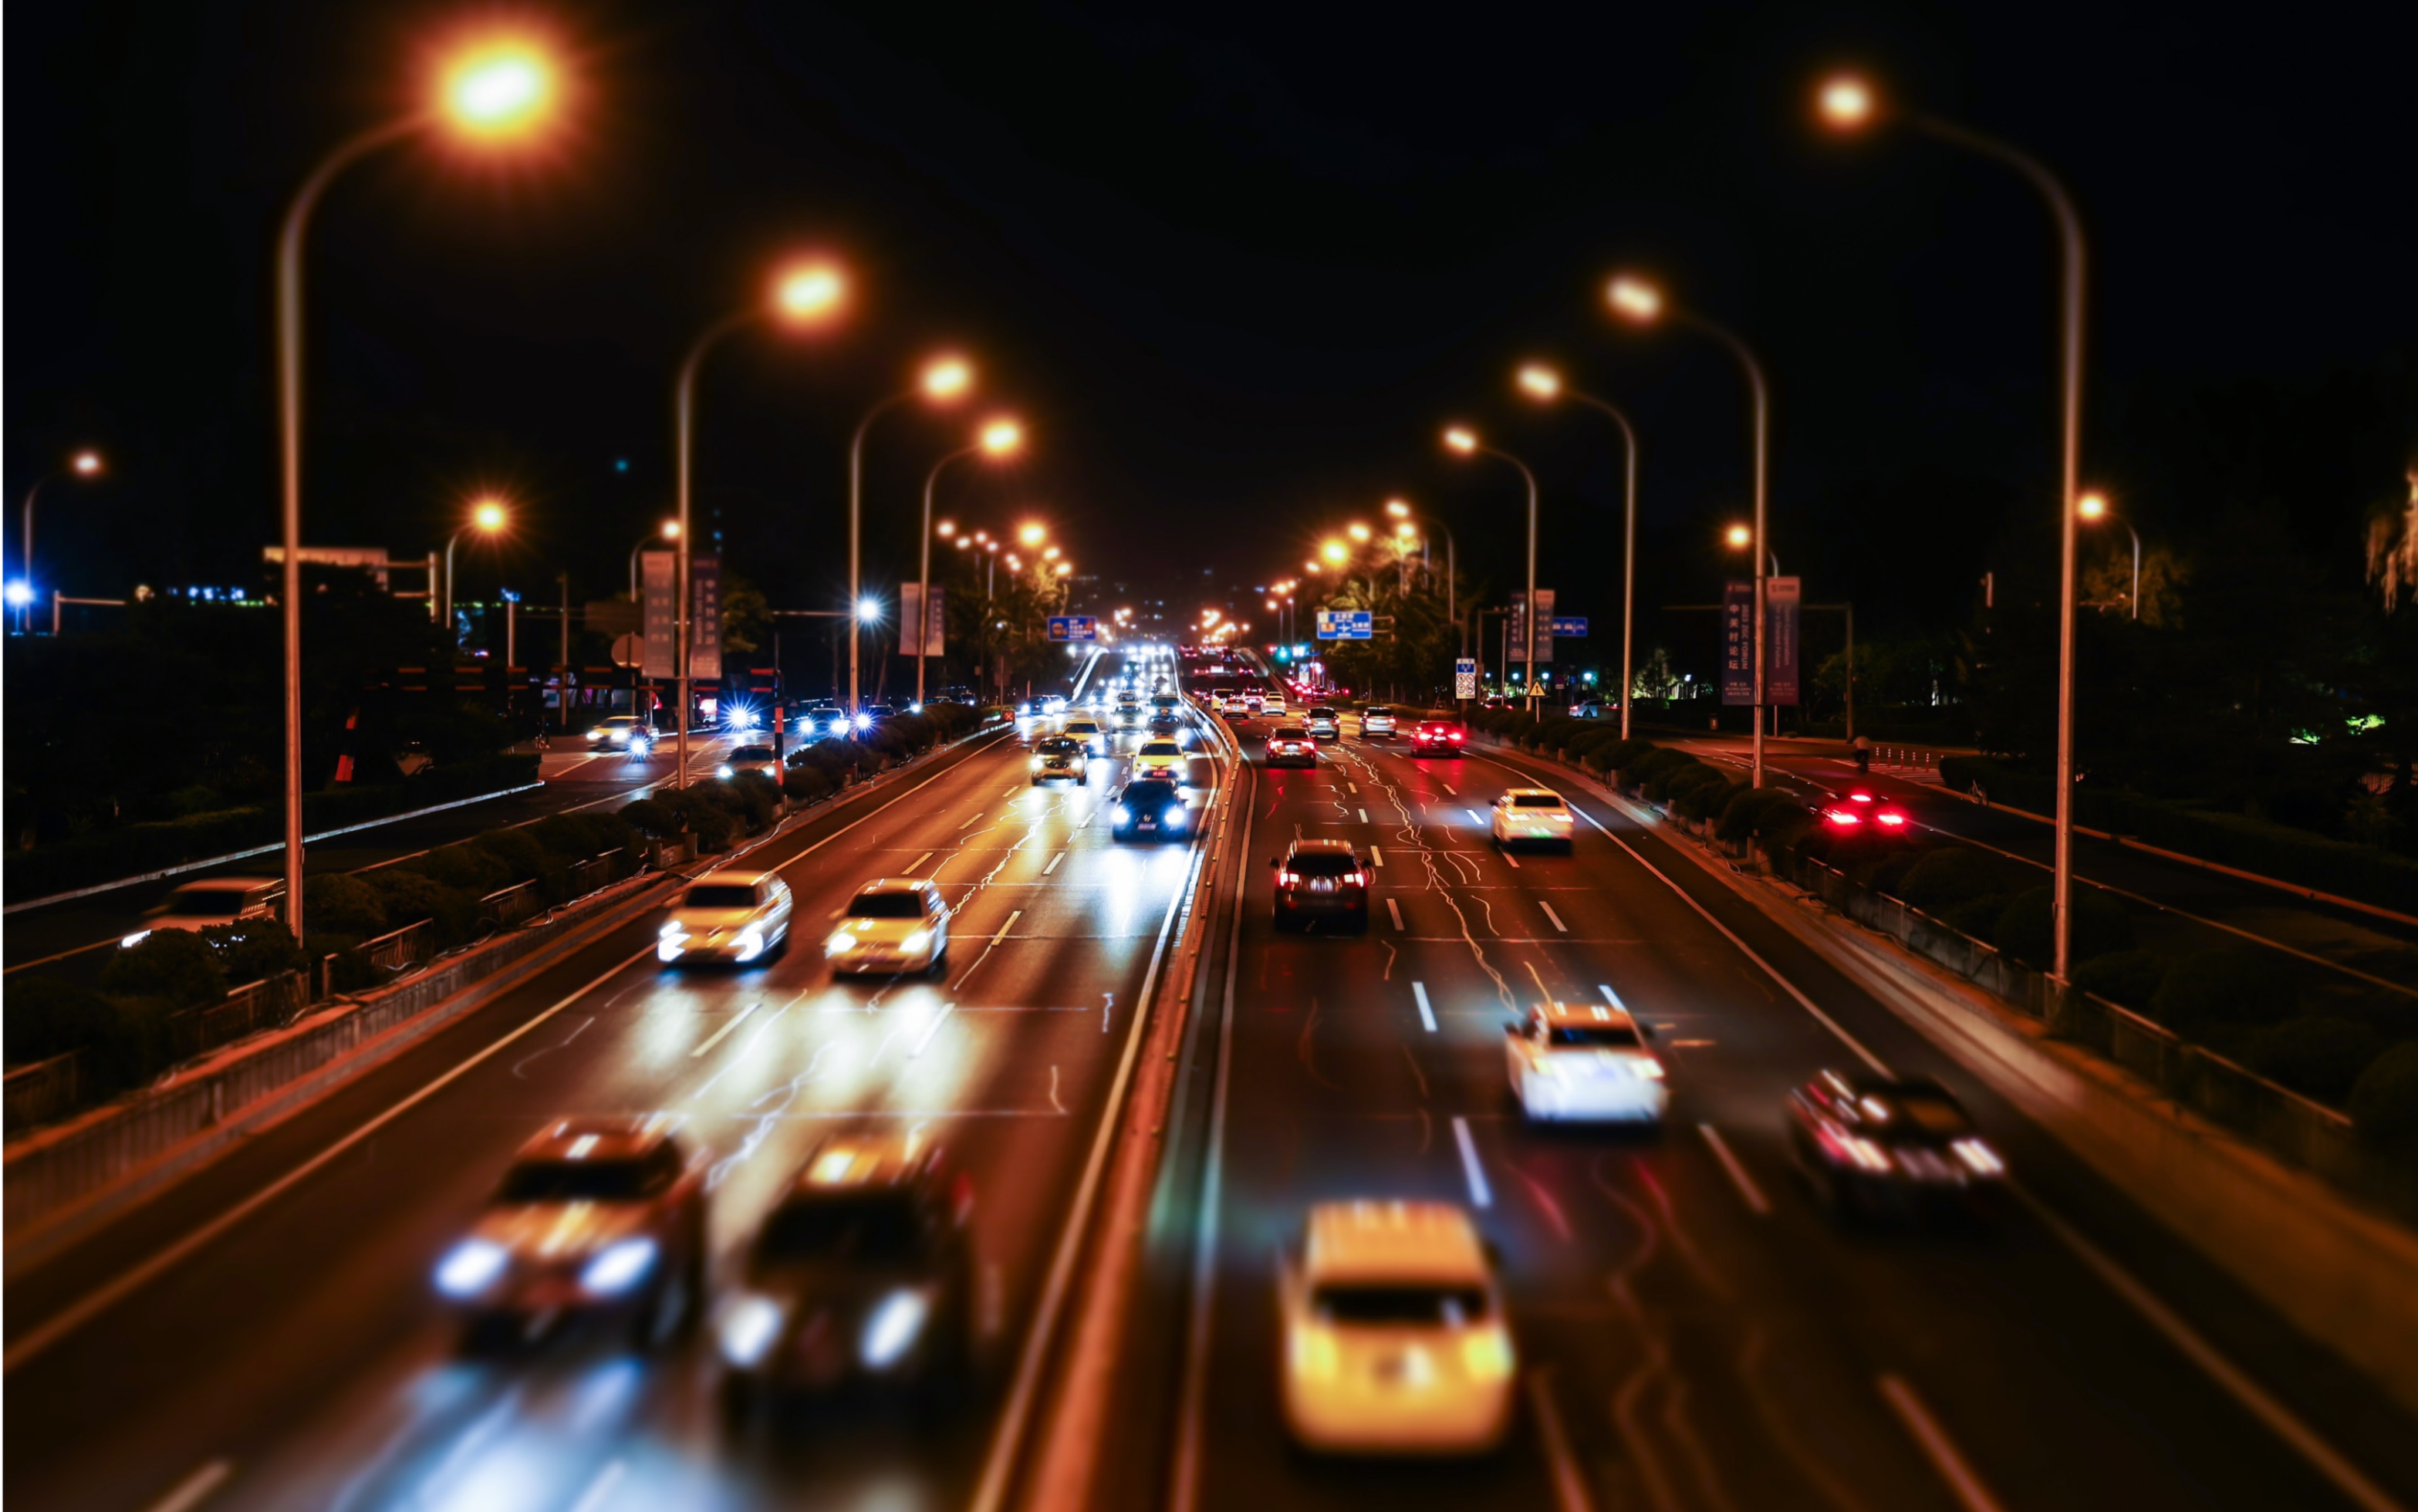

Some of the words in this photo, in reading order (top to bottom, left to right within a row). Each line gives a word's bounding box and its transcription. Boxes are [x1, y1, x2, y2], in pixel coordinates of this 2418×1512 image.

[1728, 603, 1739, 670] 中关村论坛
